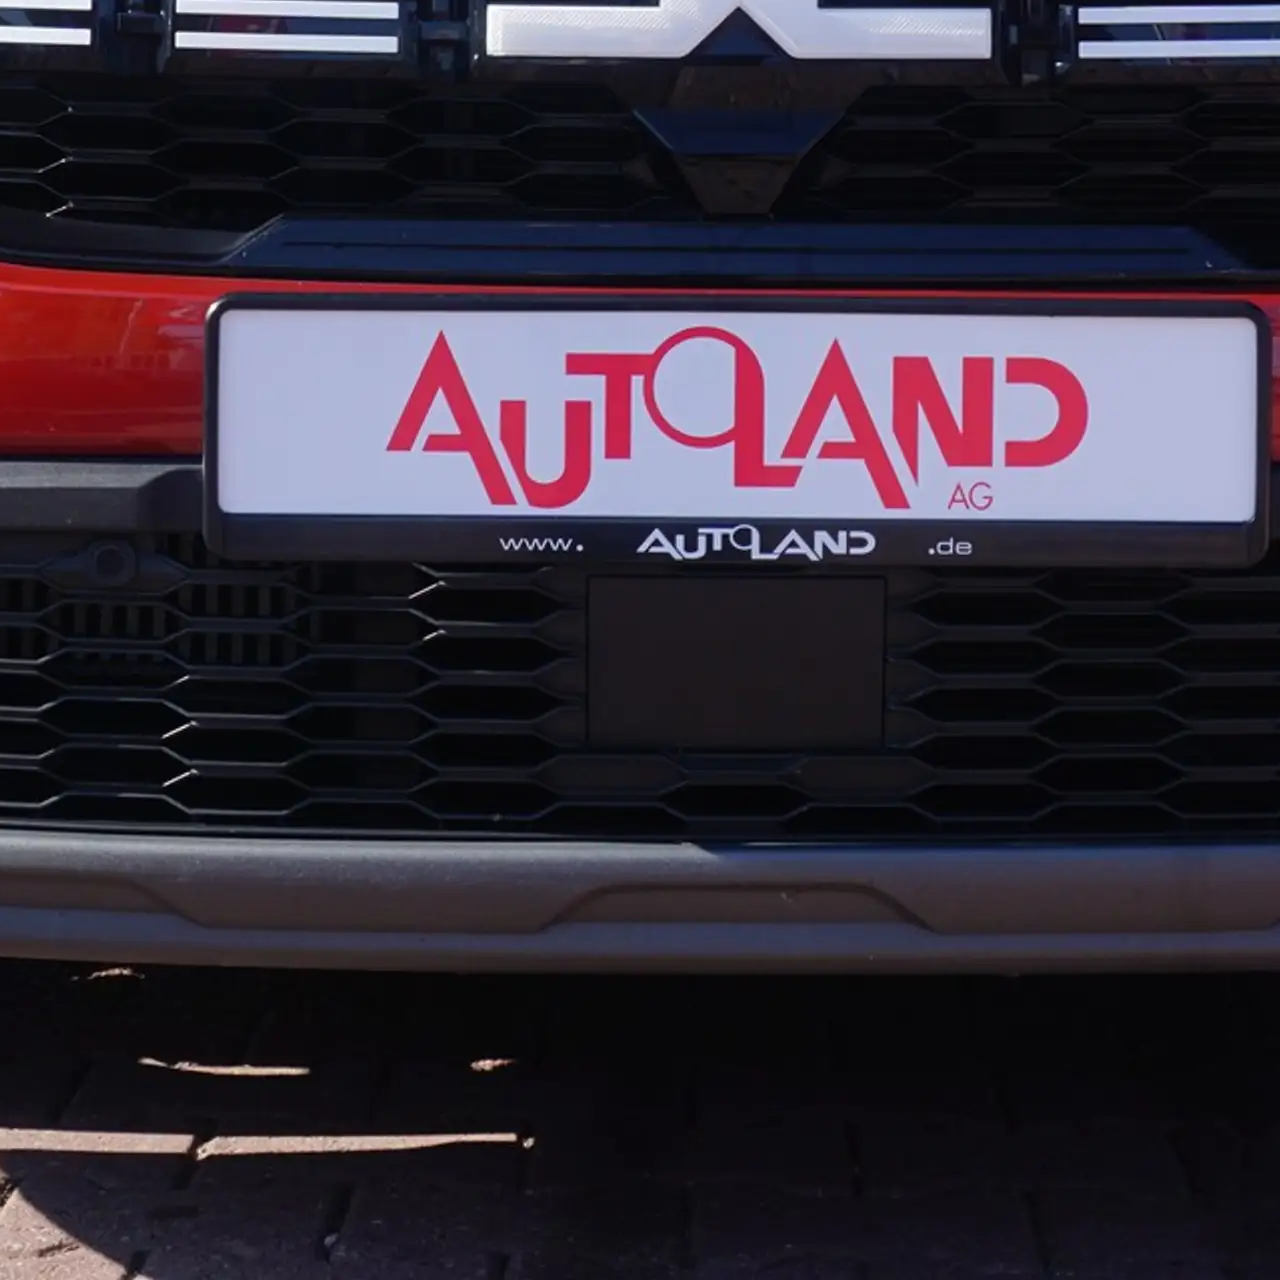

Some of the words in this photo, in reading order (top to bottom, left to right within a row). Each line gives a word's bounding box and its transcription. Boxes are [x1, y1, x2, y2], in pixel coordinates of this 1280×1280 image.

[387, 326, 1088, 509] AUTOLAND
[947, 481, 994, 511] AG
[499, 536, 584, 553] www.
[636, 523, 877, 562] AUTOLAND
[927, 536, 973, 556] .de
